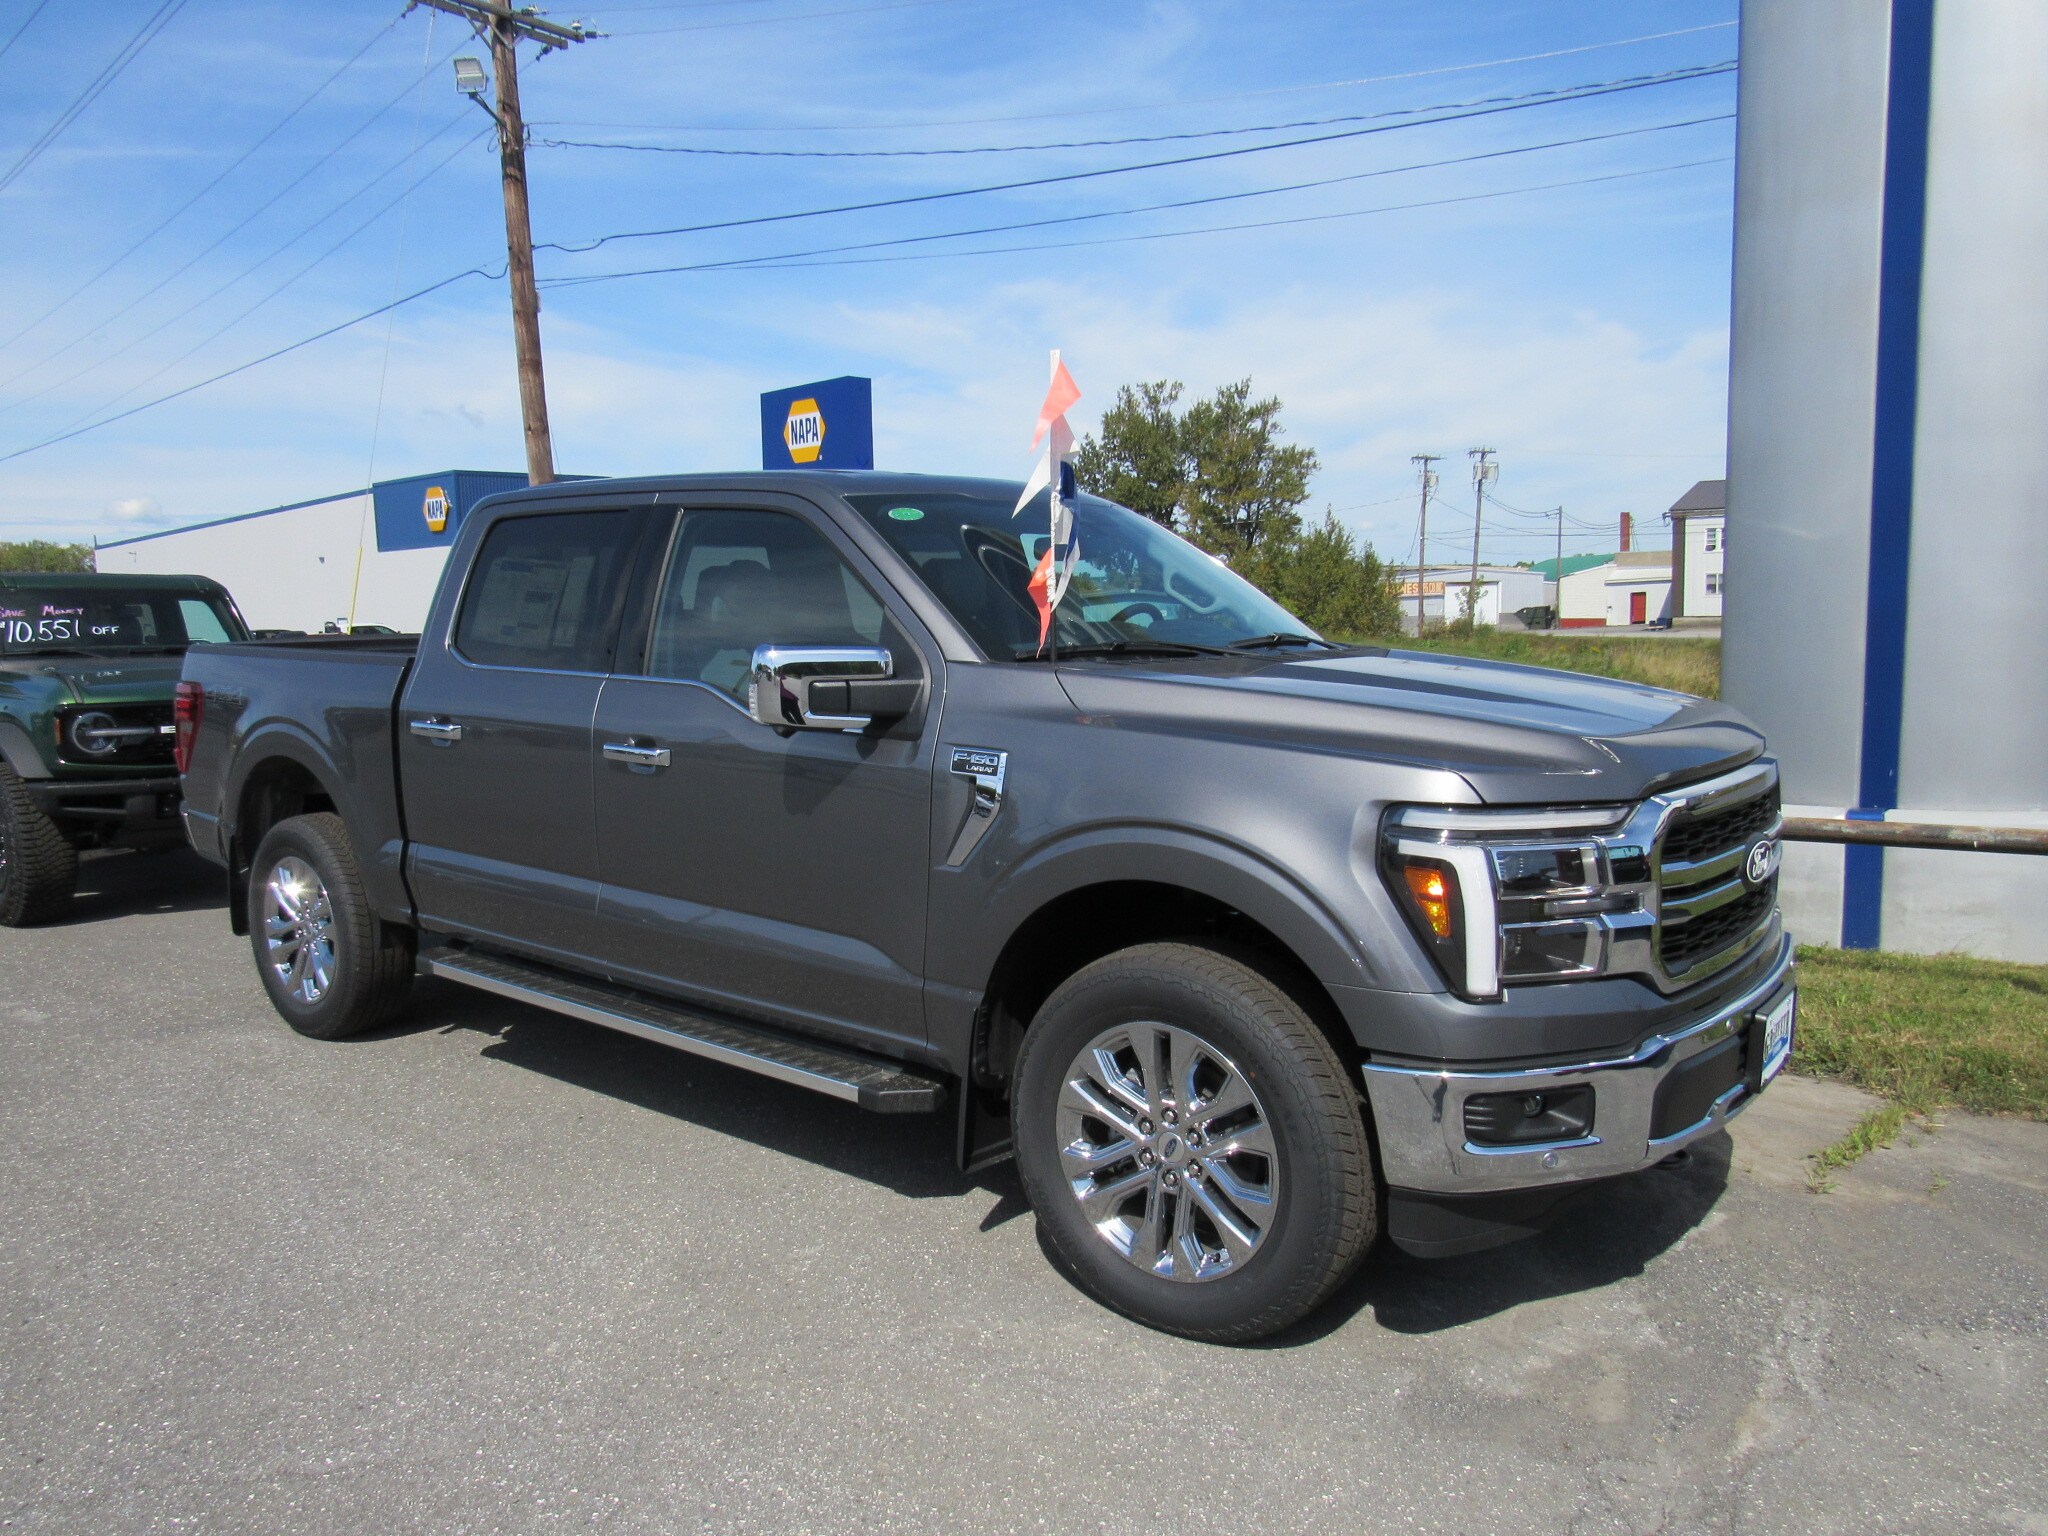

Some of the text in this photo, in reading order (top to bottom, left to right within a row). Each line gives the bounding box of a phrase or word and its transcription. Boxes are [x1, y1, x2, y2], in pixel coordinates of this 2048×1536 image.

[790, 416, 819, 446] NAPA
[427, 500, 444, 520] NAPA
[92, 625, 120, 635] OFF
[953, 752, 998, 766] F-150
[965, 764, 995, 773] LARIAT
[1752, 846, 1769, 878] Ford
